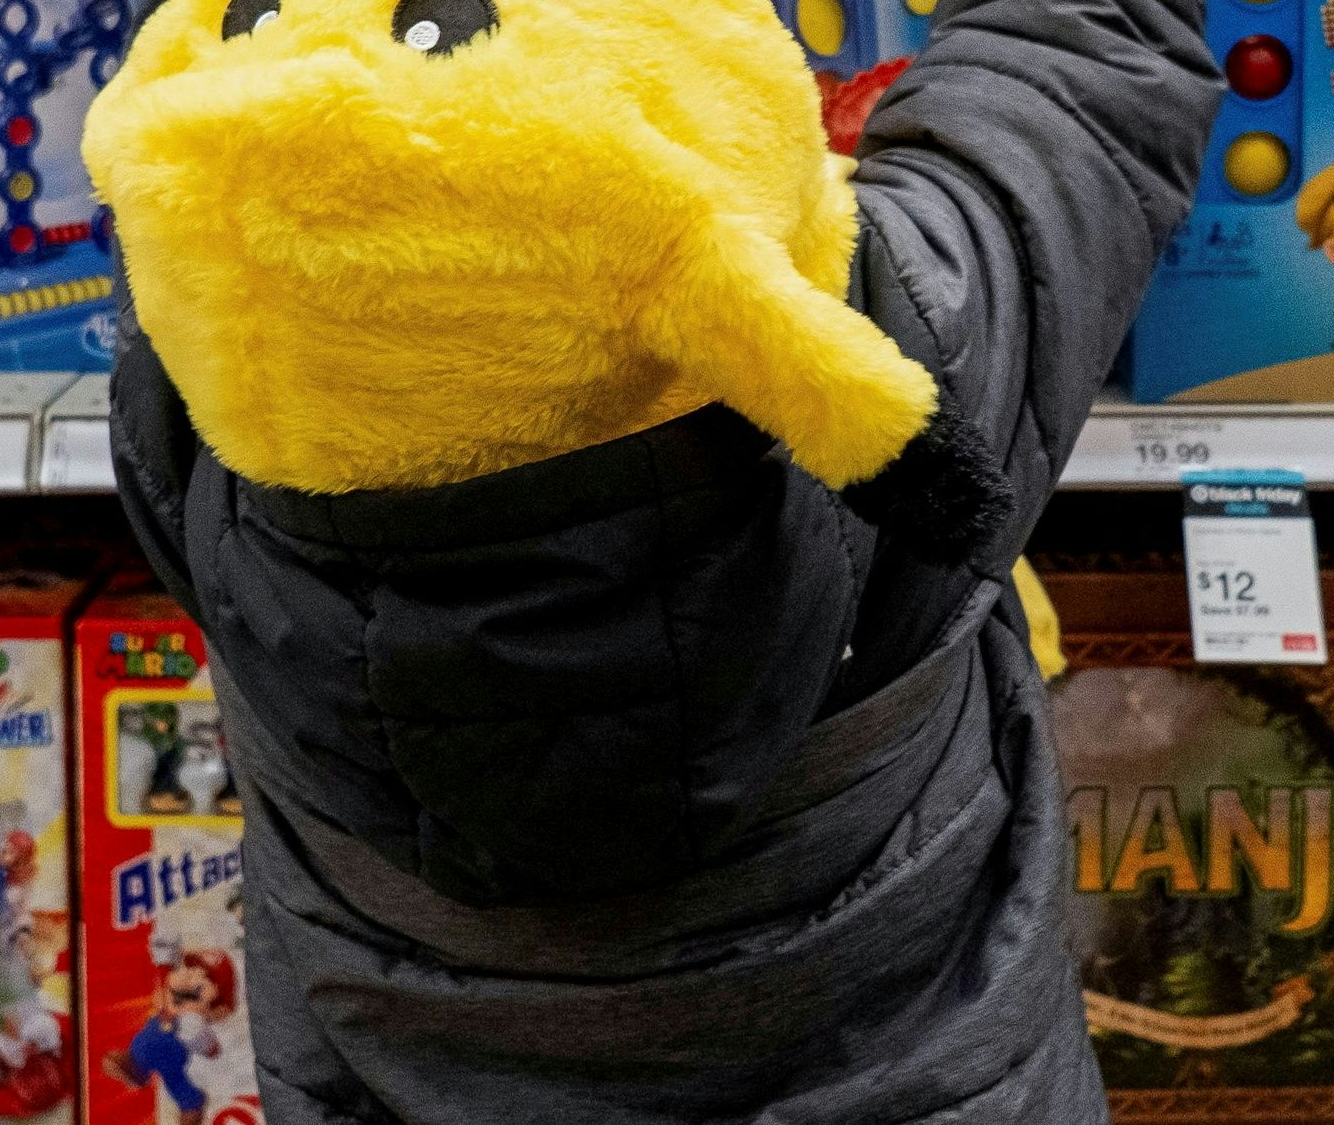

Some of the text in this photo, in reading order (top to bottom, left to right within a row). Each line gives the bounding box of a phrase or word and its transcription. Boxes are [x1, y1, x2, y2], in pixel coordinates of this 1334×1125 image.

[1135, 441, 1211, 464] 19.99
[1197, 570, 1257, 602] $12
[116, 843, 245, 928] Attac
